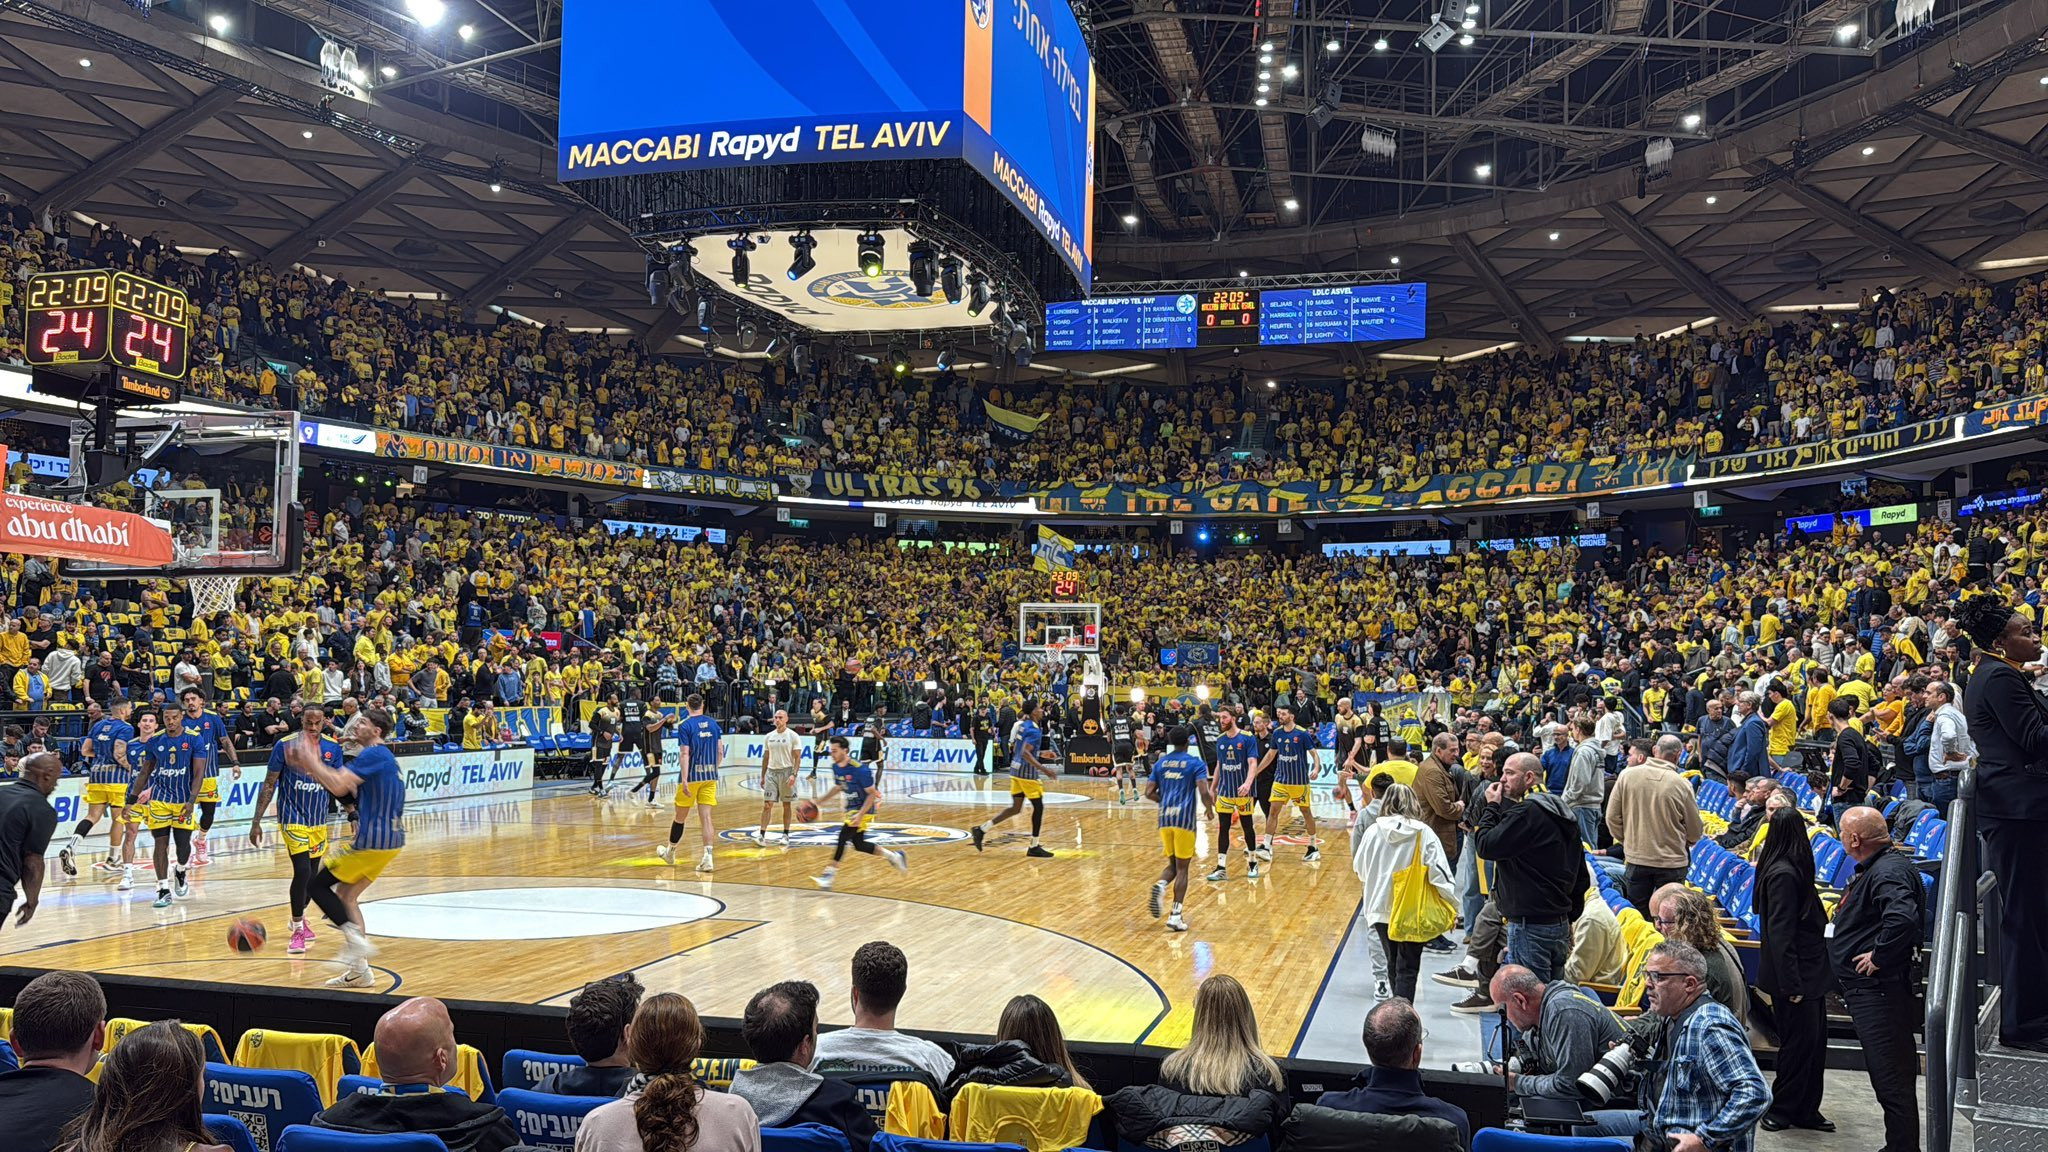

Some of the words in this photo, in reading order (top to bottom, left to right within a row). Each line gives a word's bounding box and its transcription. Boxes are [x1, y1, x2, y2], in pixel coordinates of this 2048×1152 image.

[568, 134, 700, 169] MACCABI
[709, 126, 801, 160] Rapyd
[815, 125, 864, 150] TEL
[872, 121, 951, 147] AVIV
[993, 151, 1038, 215] MACCABI
[1038, 198, 1060, 241] Rapyd
[1061, 227, 1071, 257] TEL
[1071, 242, 1083, 273] AVIV
[31, 276, 108, 307] 22:09
[1331, 287, 1352, 295] ASVEL
[116, 278, 184, 322] 22:09
[1207, 314, 1214, 325] 0
[1242, 313, 1249, 324] 0
[41, 310, 93, 353] 24
[125, 314, 172, 363] 24
[121, 375, 160, 398] Timberland
[304, 426, 312, 439] 9
[1757, 450, 1788, 469] אני
[414, 469, 427, 482] 10
[824, 472, 942, 497] ULTRAS
[947, 478, 982, 500] 96
[6, 497, 74, 514] experience
[1588, 506, 1599, 516] 12
[778, 510, 789, 519] 10
[1881, 508, 1906, 519] Rapyd
[876, 516, 885, 525] 11
[1279, 521, 1290, 531] 12
[7, 512, 58, 540] abu
[61, 517, 129, 547] dhabi
[1172, 523, 1182, 532] 11
[1580, 539, 1607, 547] DRONES
[1052, 571, 1078, 581] 22:09
[1055, 581, 1074, 594] 24
[169, 752, 176, 764] 8
[661, 750, 680, 767] Rap
[901, 747, 928, 762] TEL
[932, 748, 976, 763] AVIV
[1069, 752, 1111, 764] Timberland
[1226, 751, 1235, 760] 11
[1222, 763, 1241, 772] Rapyd
[406, 767, 451, 792] Rapyd
[461, 764, 486, 784] TEL
[488, 761, 523, 783] AVIV
[294, 780, 324, 793] Rapy
[209, 1079, 282, 1111] רעבים?
